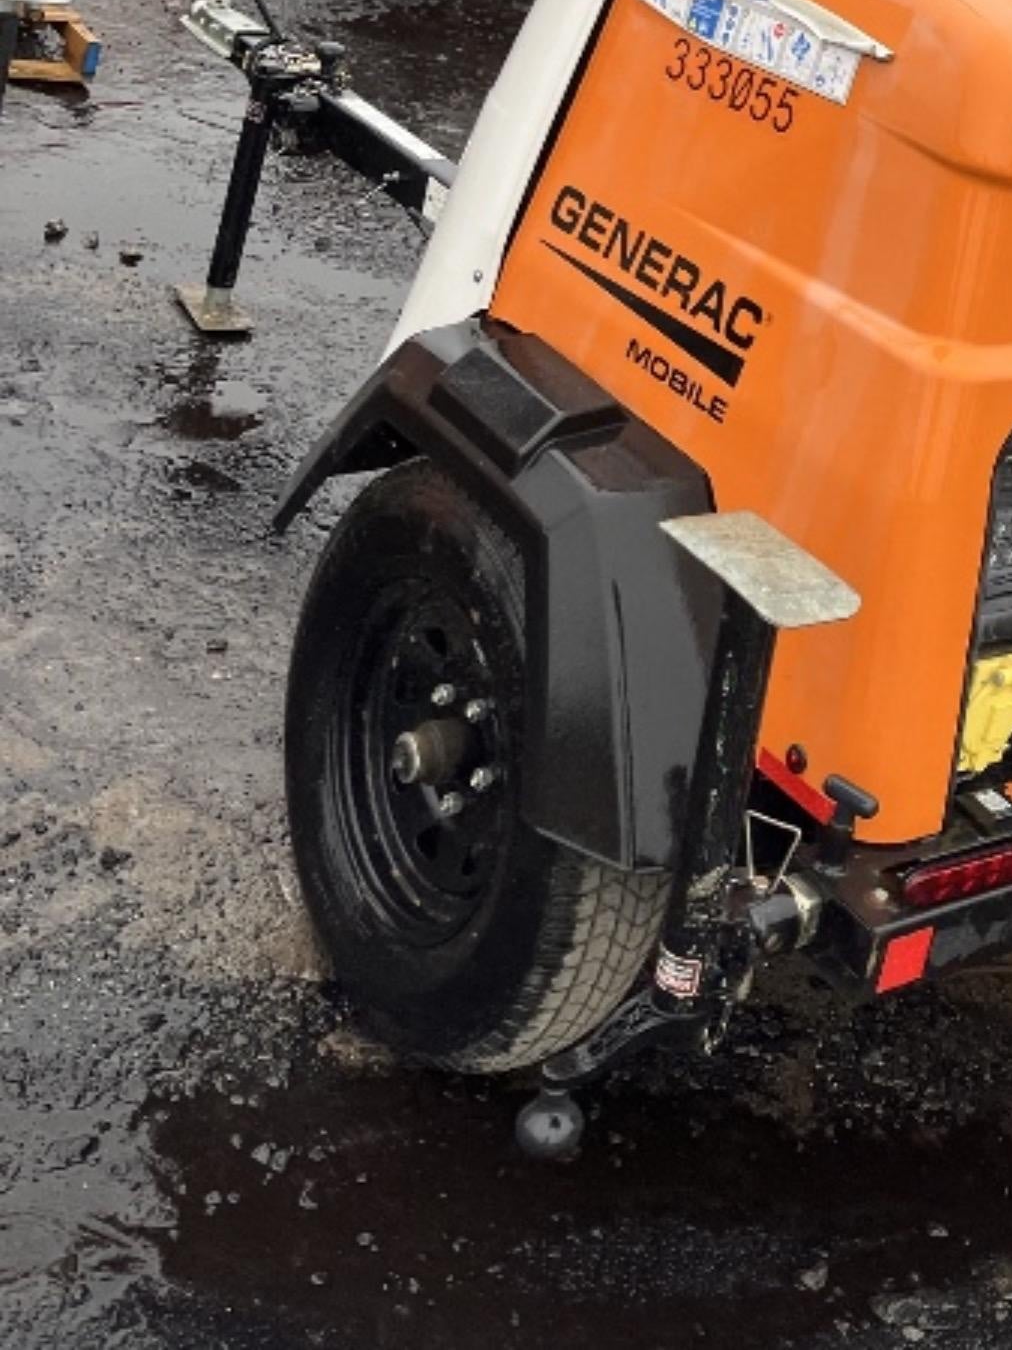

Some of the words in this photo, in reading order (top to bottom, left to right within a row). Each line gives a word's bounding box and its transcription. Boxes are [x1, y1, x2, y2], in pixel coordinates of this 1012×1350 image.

[665, 38, 799, 133] 333055
[551, 185, 763, 350] GENERAC
[626, 338, 728, 424] MOBILE
